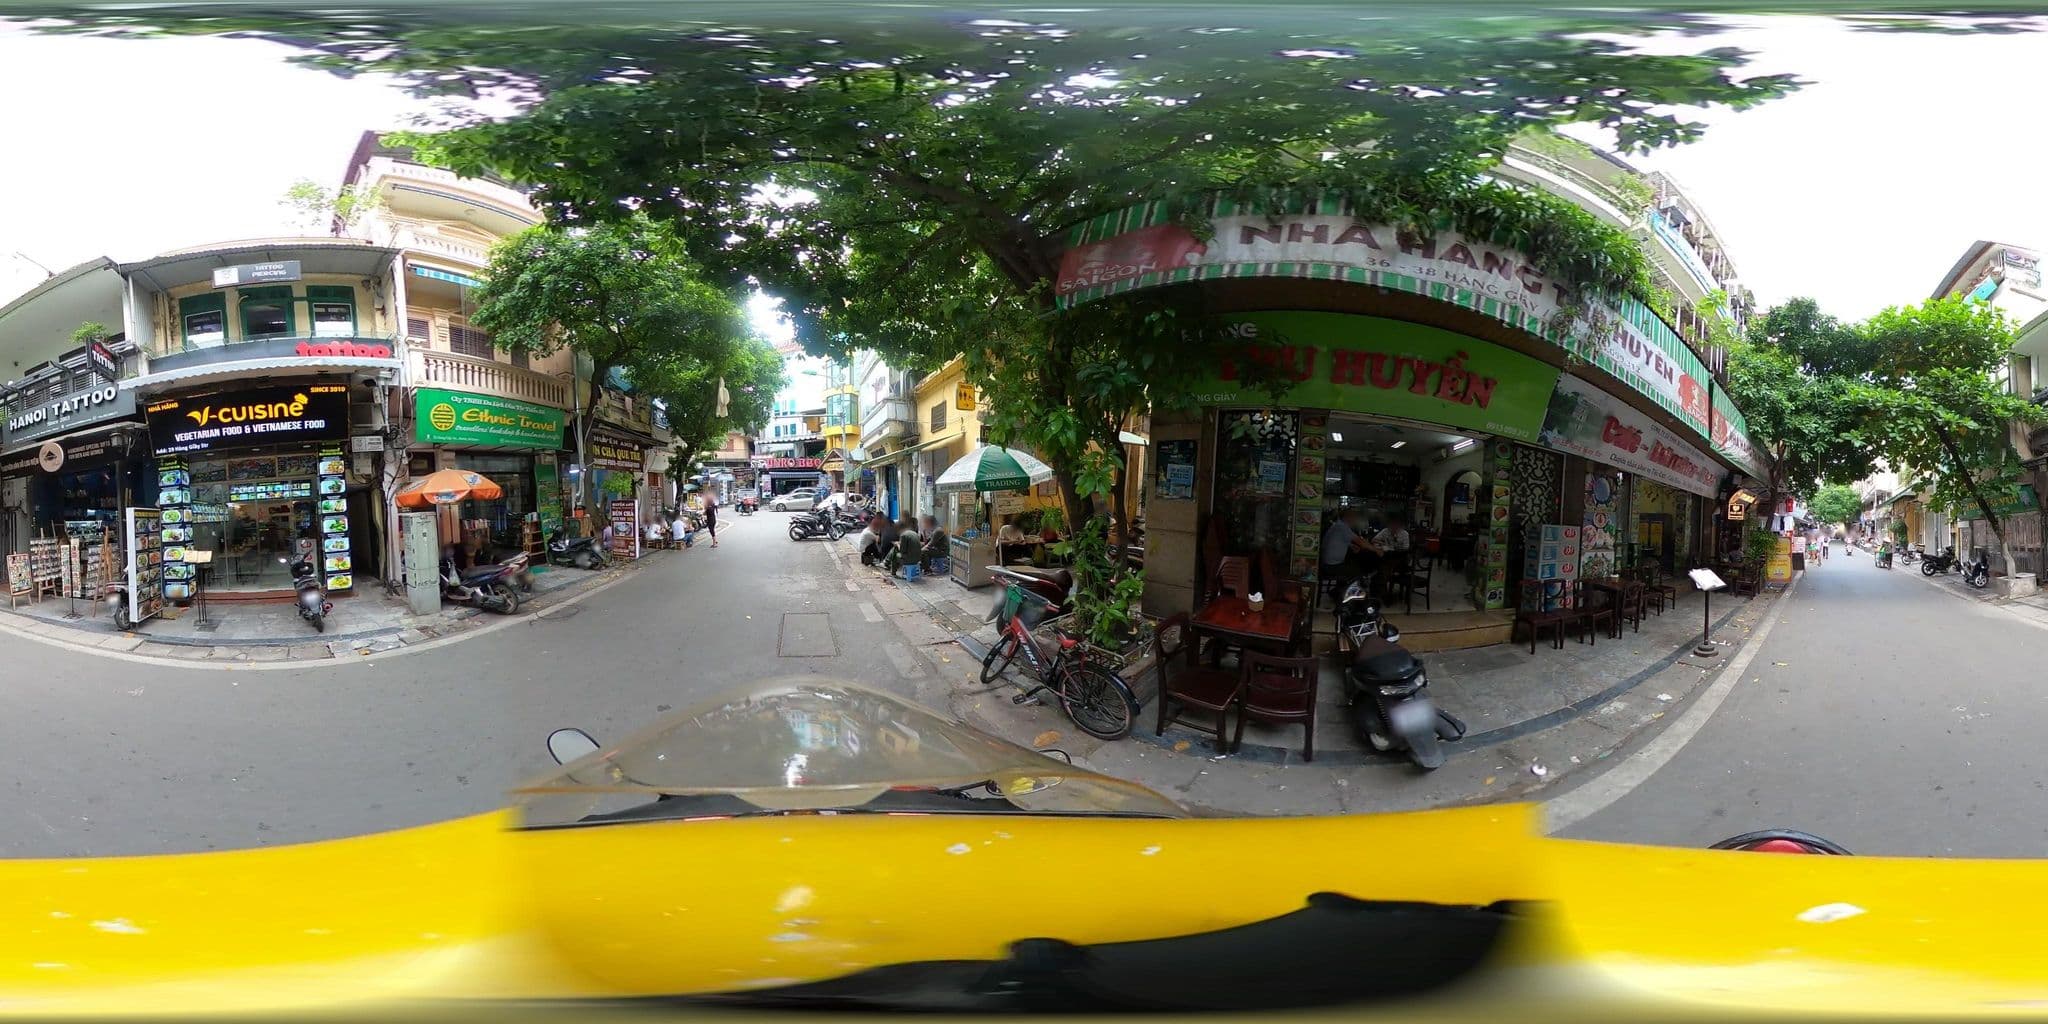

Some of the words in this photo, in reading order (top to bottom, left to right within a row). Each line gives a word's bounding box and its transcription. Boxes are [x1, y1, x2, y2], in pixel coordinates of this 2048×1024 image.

[1366, 256, 1391, 267] 36
[1413, 265, 1436, 277] 38
[9, 407, 47, 432] HANOI
[51, 386, 117, 417] TATTOO
[462, 408, 515, 425] Ethnic
[517, 414, 557, 432] Travel
[174, 428, 221, 442] VEGETARIAN
[222, 426, 243, 437] FOOD
[244, 425, 251, 434] &
[252, 421, 302, 433] VIETNAMESE
[304, 419, 325, 430] FOOD
[799, 457, 822, 468] BBQ
[985, 479, 1021, 488] TRADING
